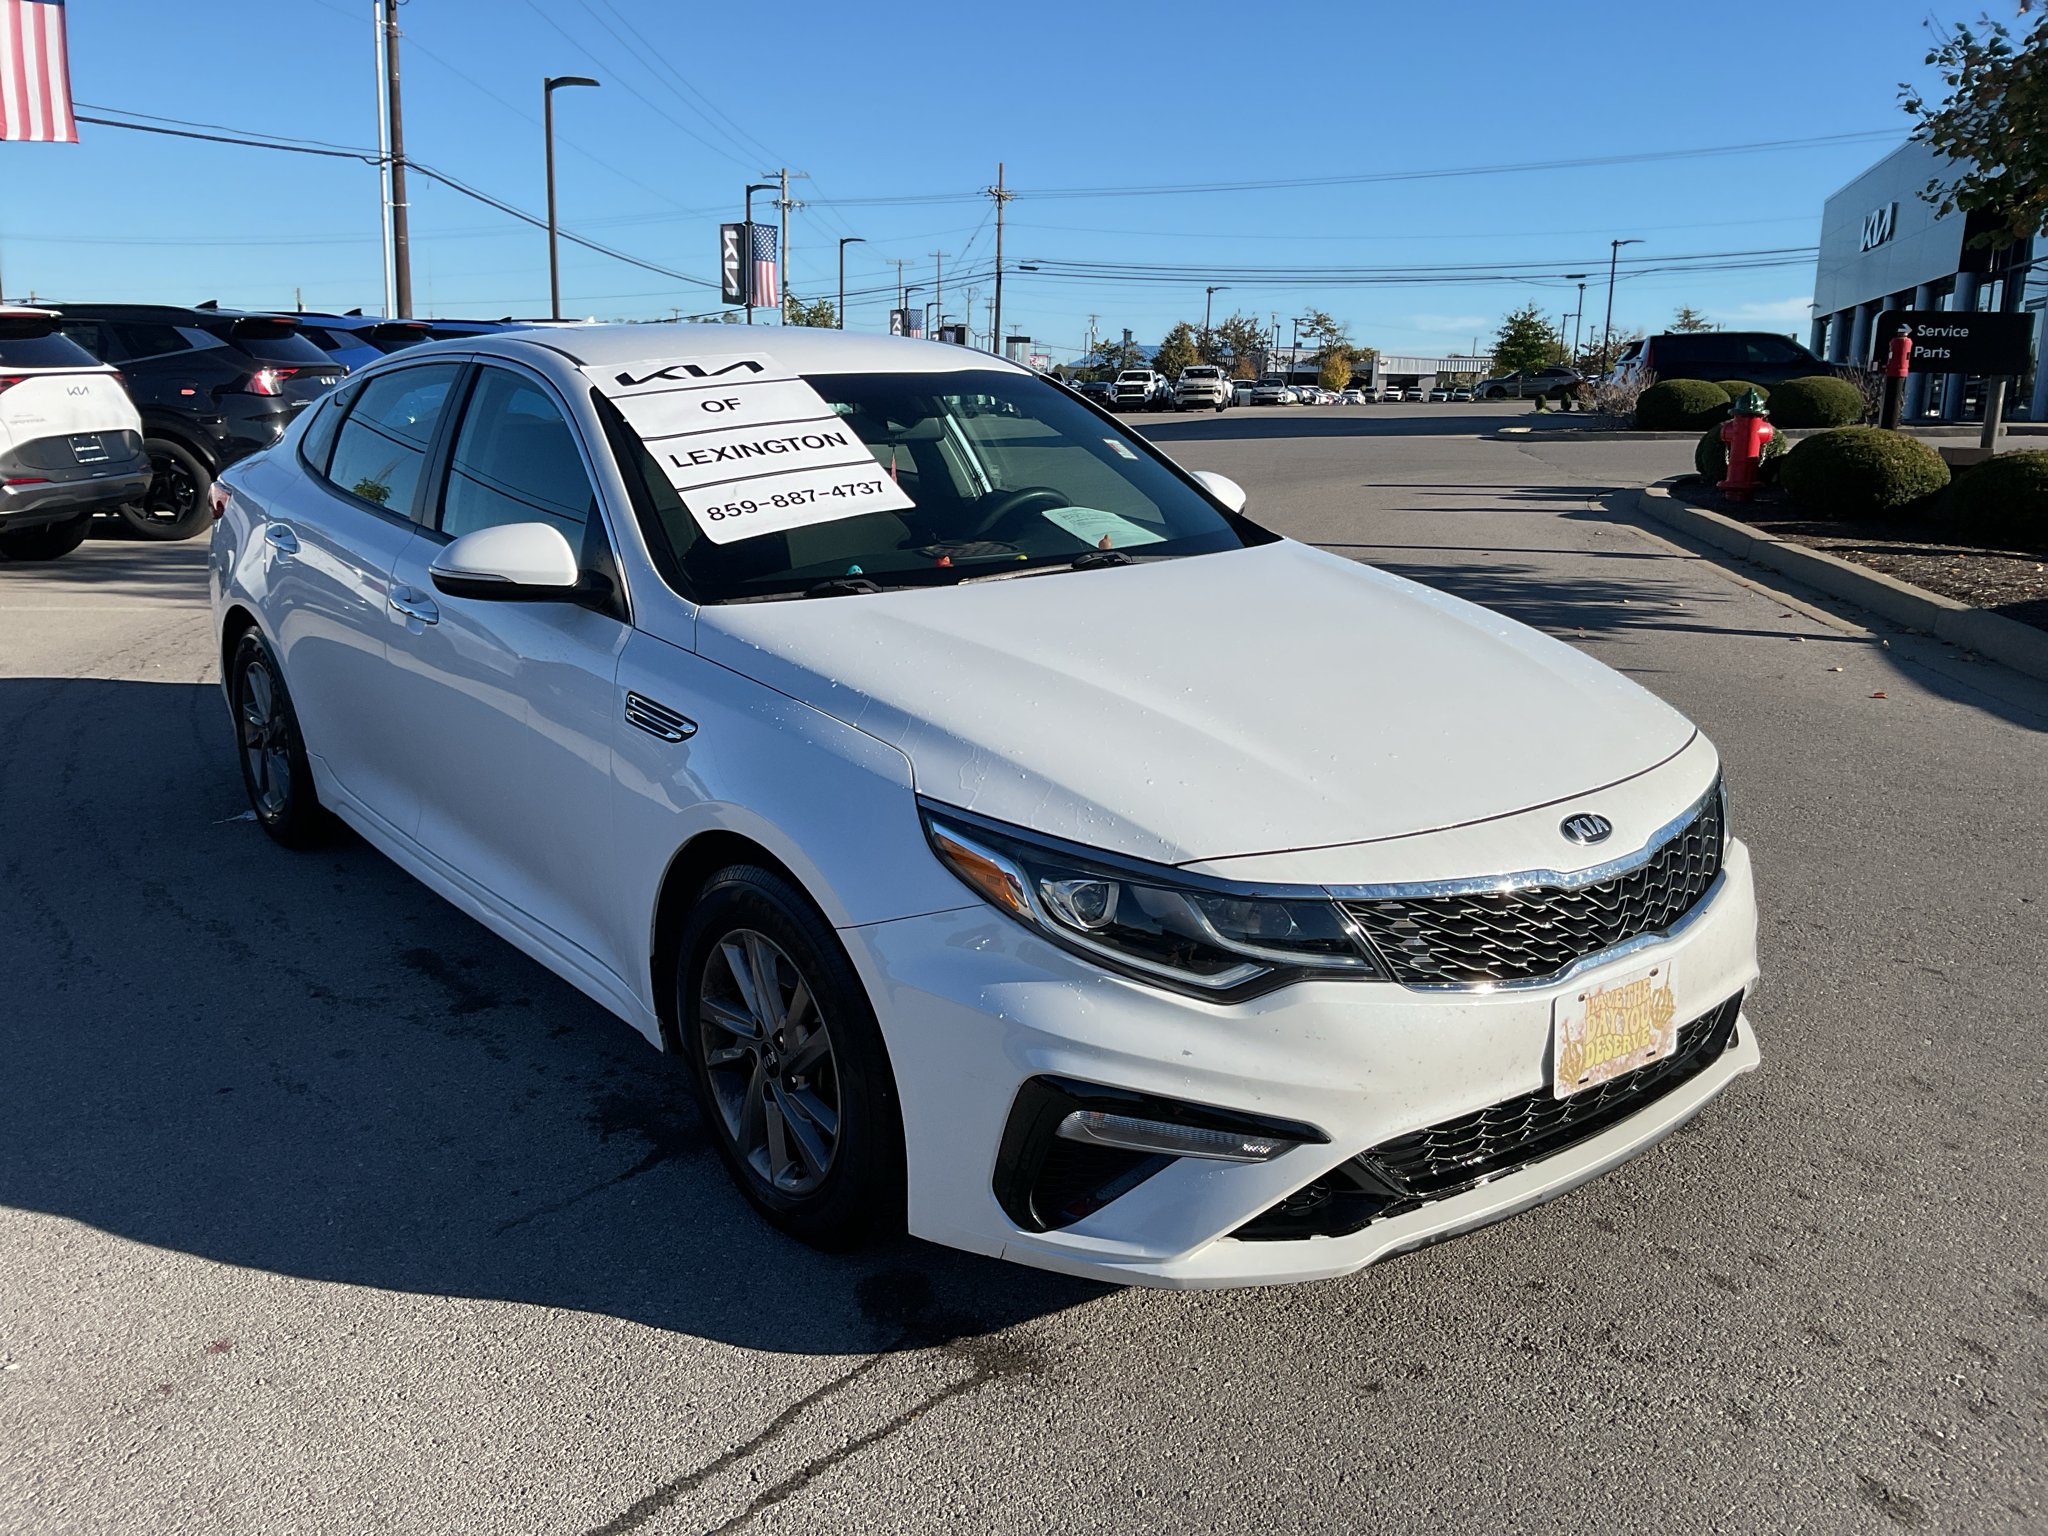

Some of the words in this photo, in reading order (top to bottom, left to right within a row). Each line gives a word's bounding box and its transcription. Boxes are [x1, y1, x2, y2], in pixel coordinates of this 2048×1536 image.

[1917, 324, 1969, 338] Service
[1914, 346, 1950, 359] Parts
[614, 361, 765, 387] KIA
[701, 397, 741, 413] OF
[668, 432, 849, 468] LEXINGTON
[707, 480, 884, 521] 859-887-4737
[1566, 815, 1610, 840] KIA
[1585, 987, 1624, 1017] HAVE
[1625, 977, 1651, 1006] THE
[1585, 1007, 1618, 1044] DAY
[1622, 1000, 1651, 1036] YOU
[1584, 1026, 1650, 1070] DESERVE
